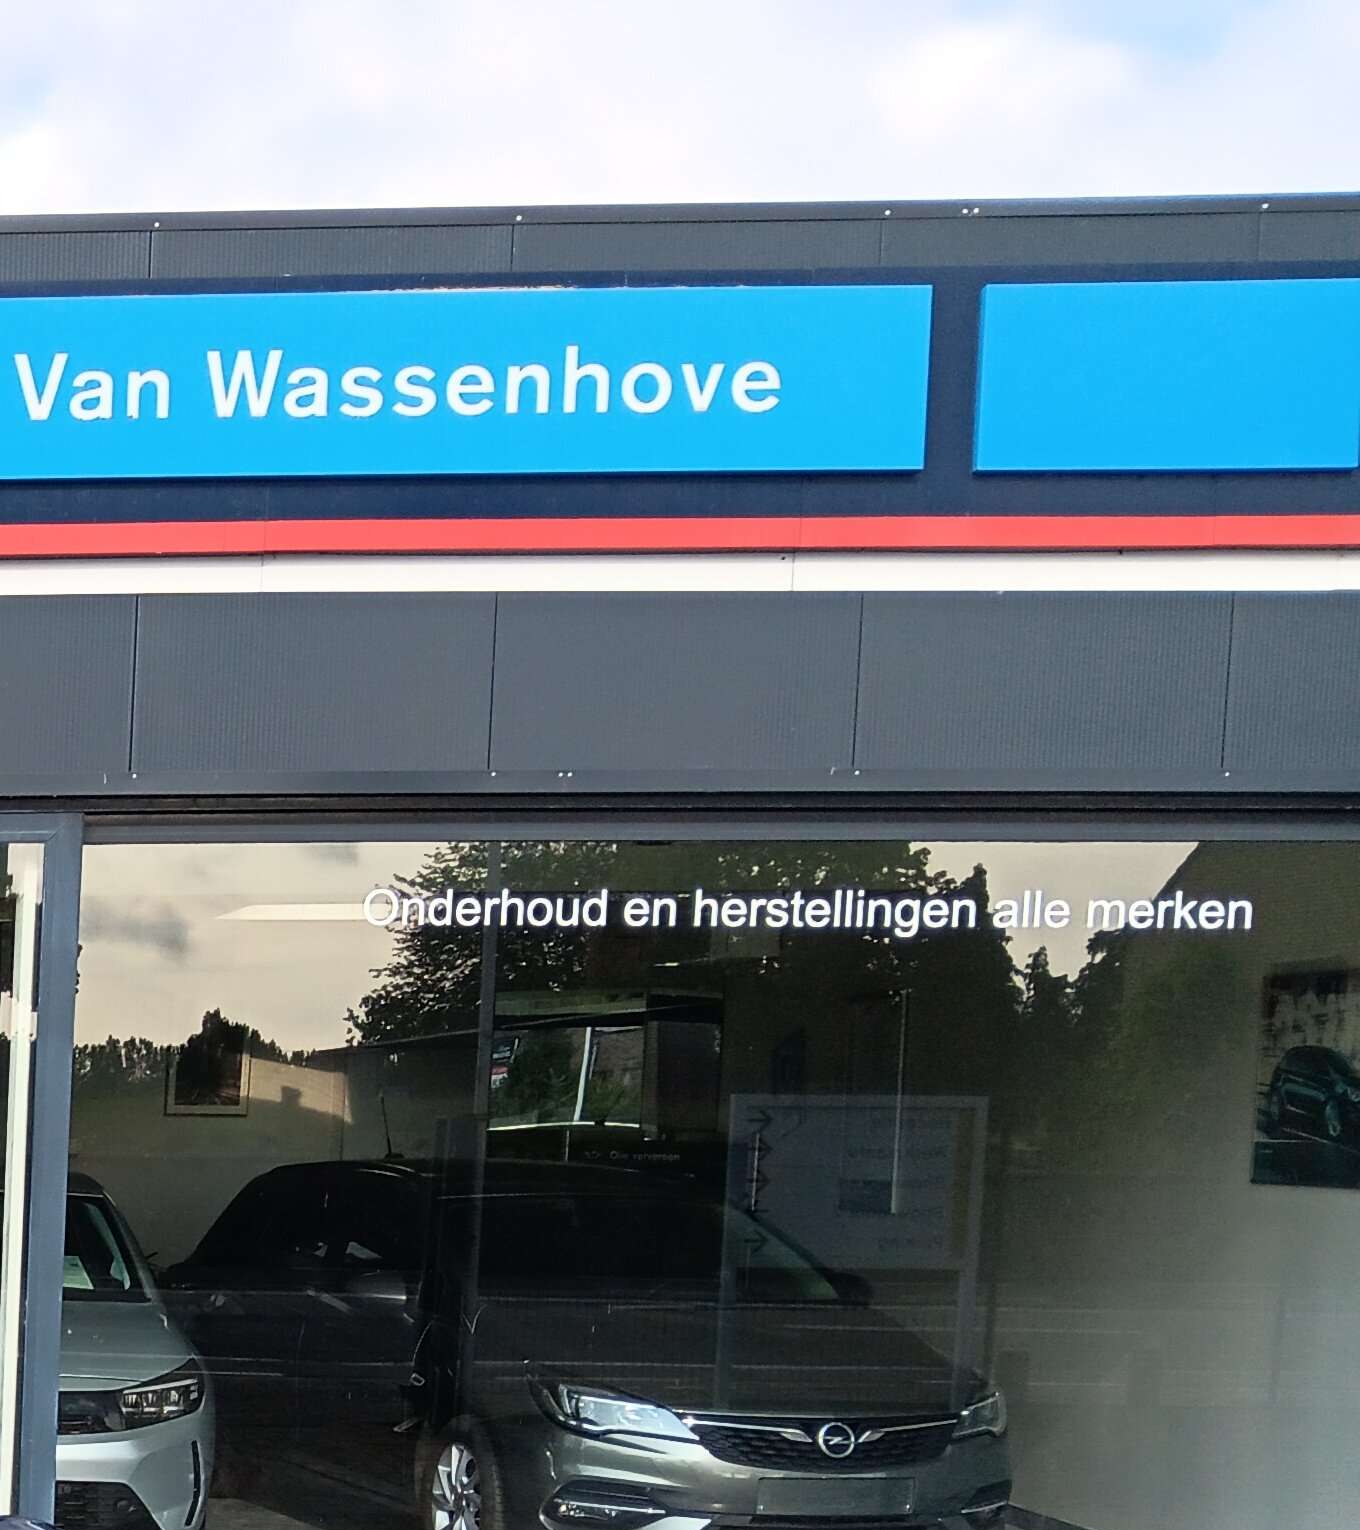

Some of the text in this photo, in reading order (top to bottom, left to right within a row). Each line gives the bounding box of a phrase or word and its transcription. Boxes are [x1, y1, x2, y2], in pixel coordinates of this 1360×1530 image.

[15, 346, 780, 420] Van Wassenhove
[362, 888, 1253, 938] Onderhoud en herstellingen alle merken
